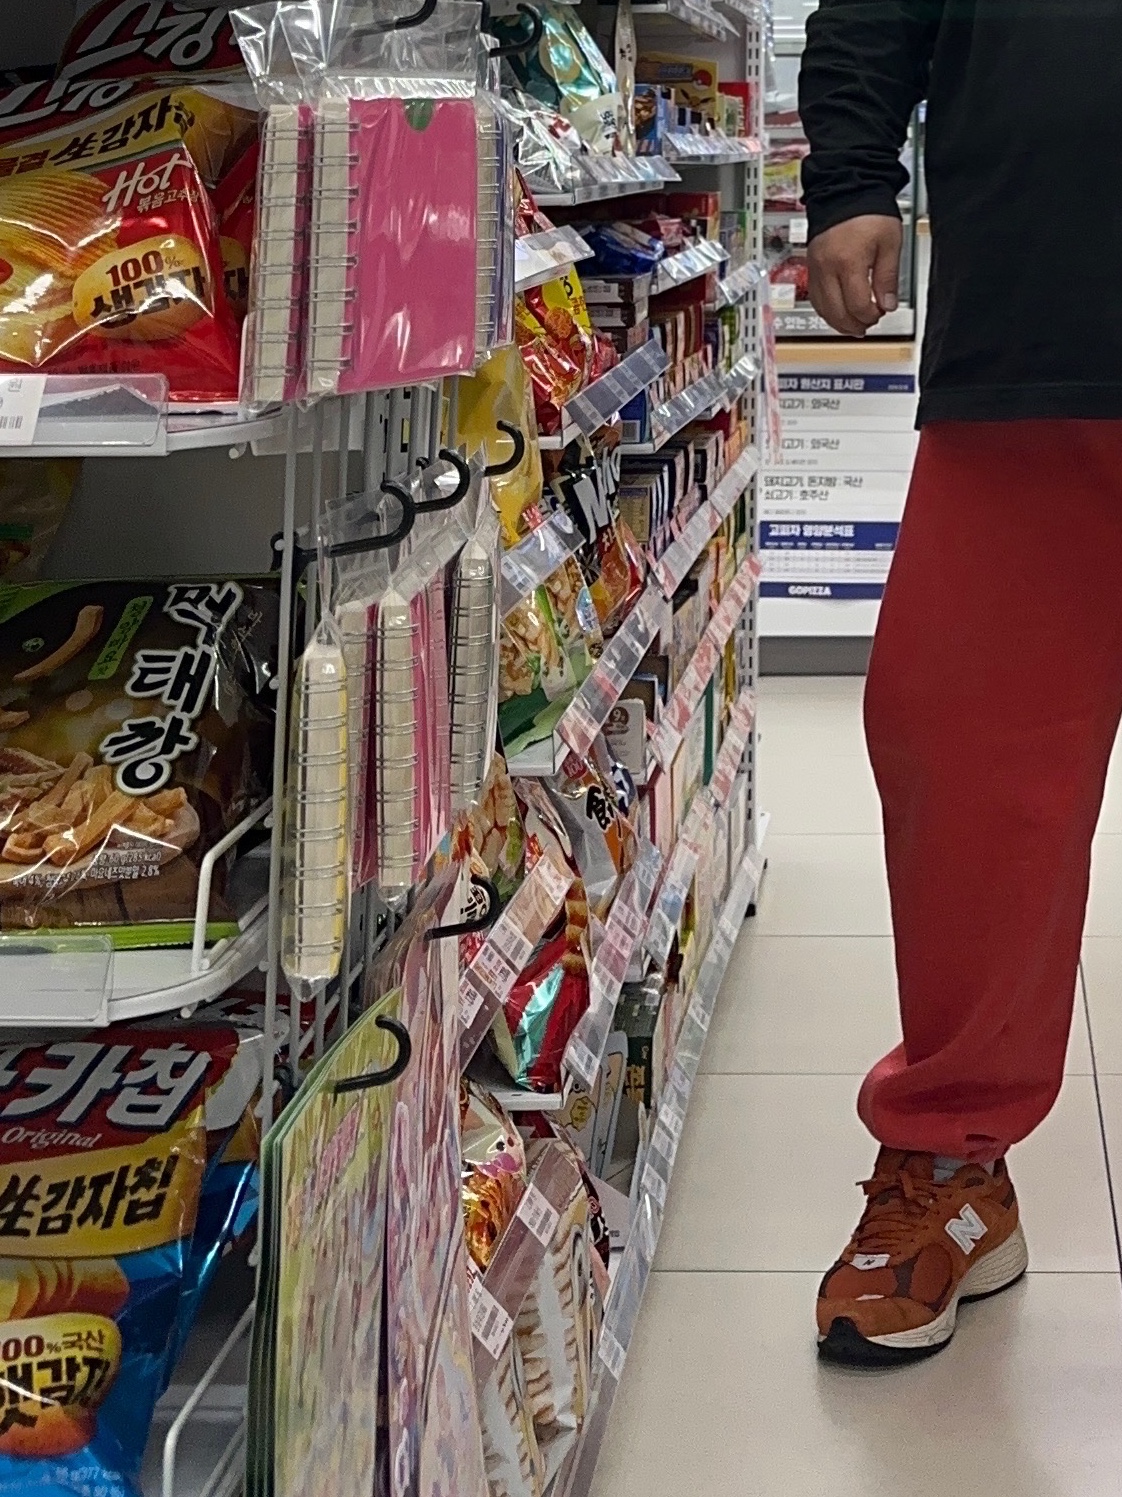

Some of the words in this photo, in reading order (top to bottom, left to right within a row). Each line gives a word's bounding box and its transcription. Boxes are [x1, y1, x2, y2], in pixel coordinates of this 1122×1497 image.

[102, 152, 193, 213] Hot
[788, 585, 832, 597] GOPIZZA
[101, 583, 240, 793] 먹태깡
[1, 1127, 102, 1149] Original
[945, 1203, 988, 1254] N
[0, 1335, 62, 1362] 00%
[62, 1329, 105, 1352] 국산
